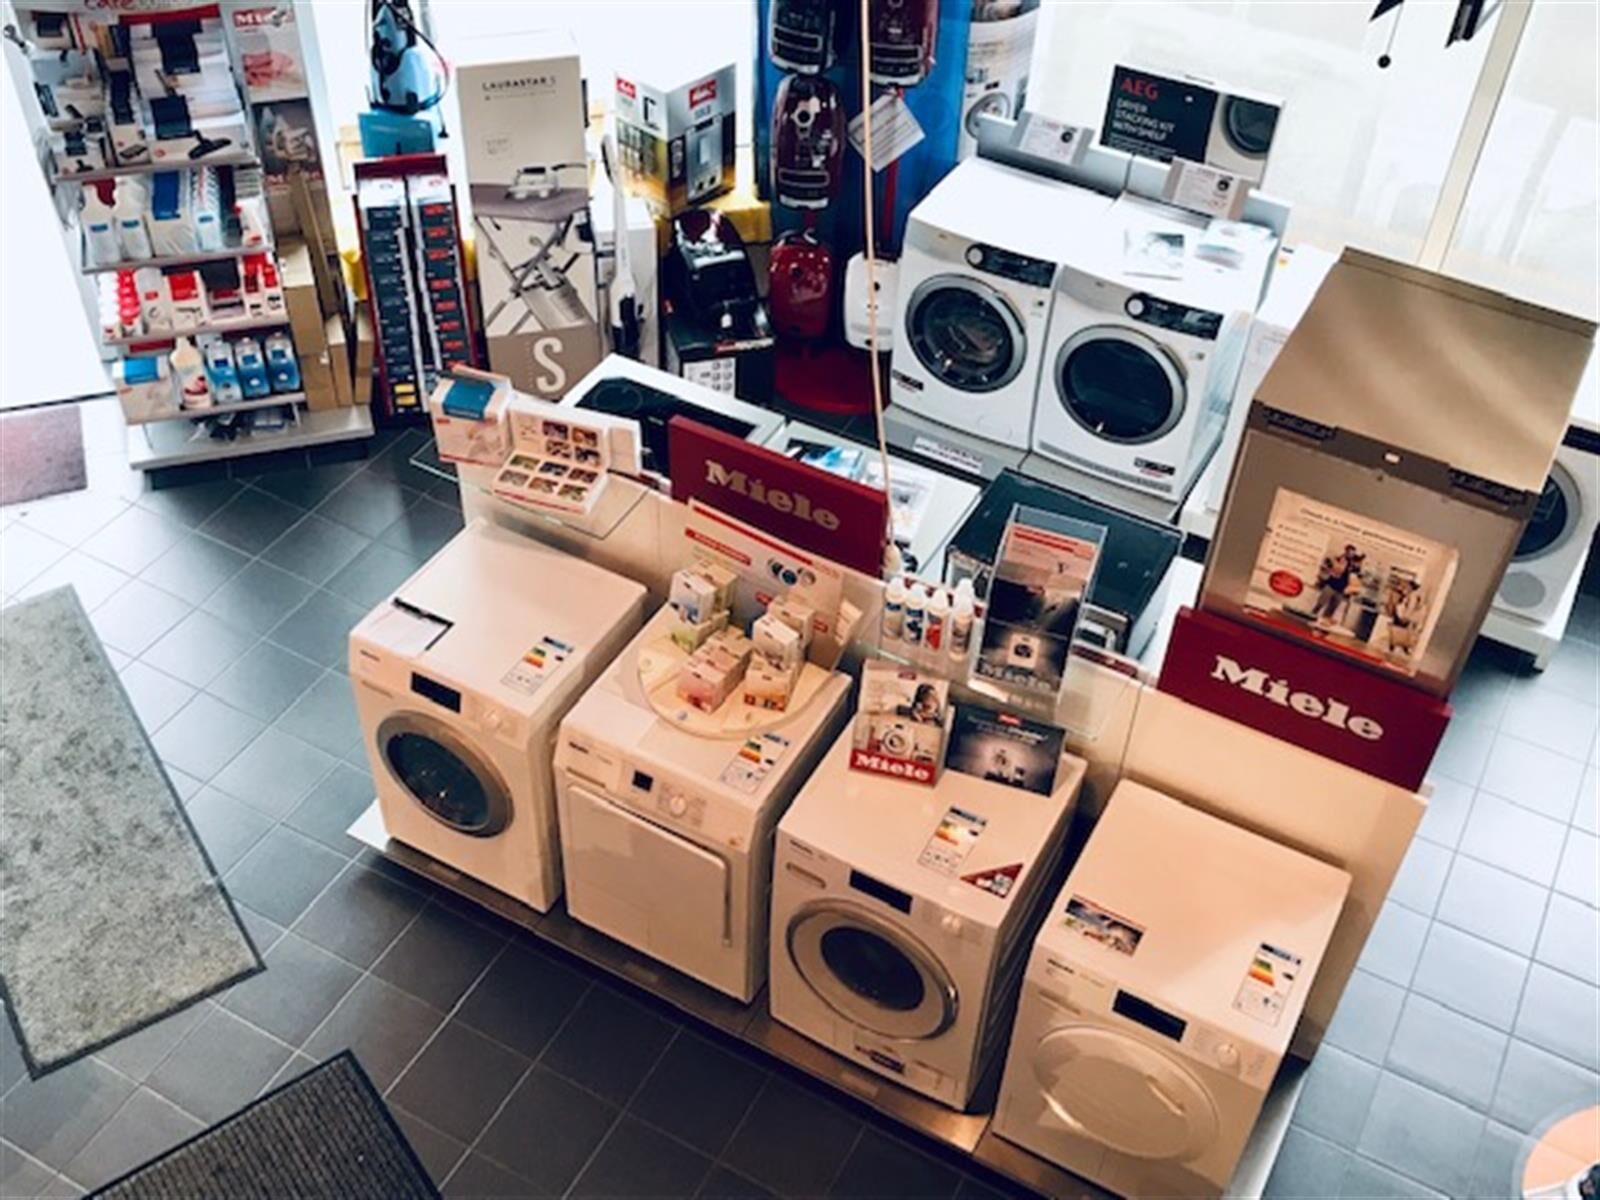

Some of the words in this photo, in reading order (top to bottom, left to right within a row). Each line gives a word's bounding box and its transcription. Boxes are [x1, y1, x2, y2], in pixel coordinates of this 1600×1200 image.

[1121, 79, 1158, 101] AEG
[533, 337, 567, 392] S
[705, 459, 840, 532] Miele
[1211, 655, 1384, 741] Miele
[854, 752, 929, 781] Miele
